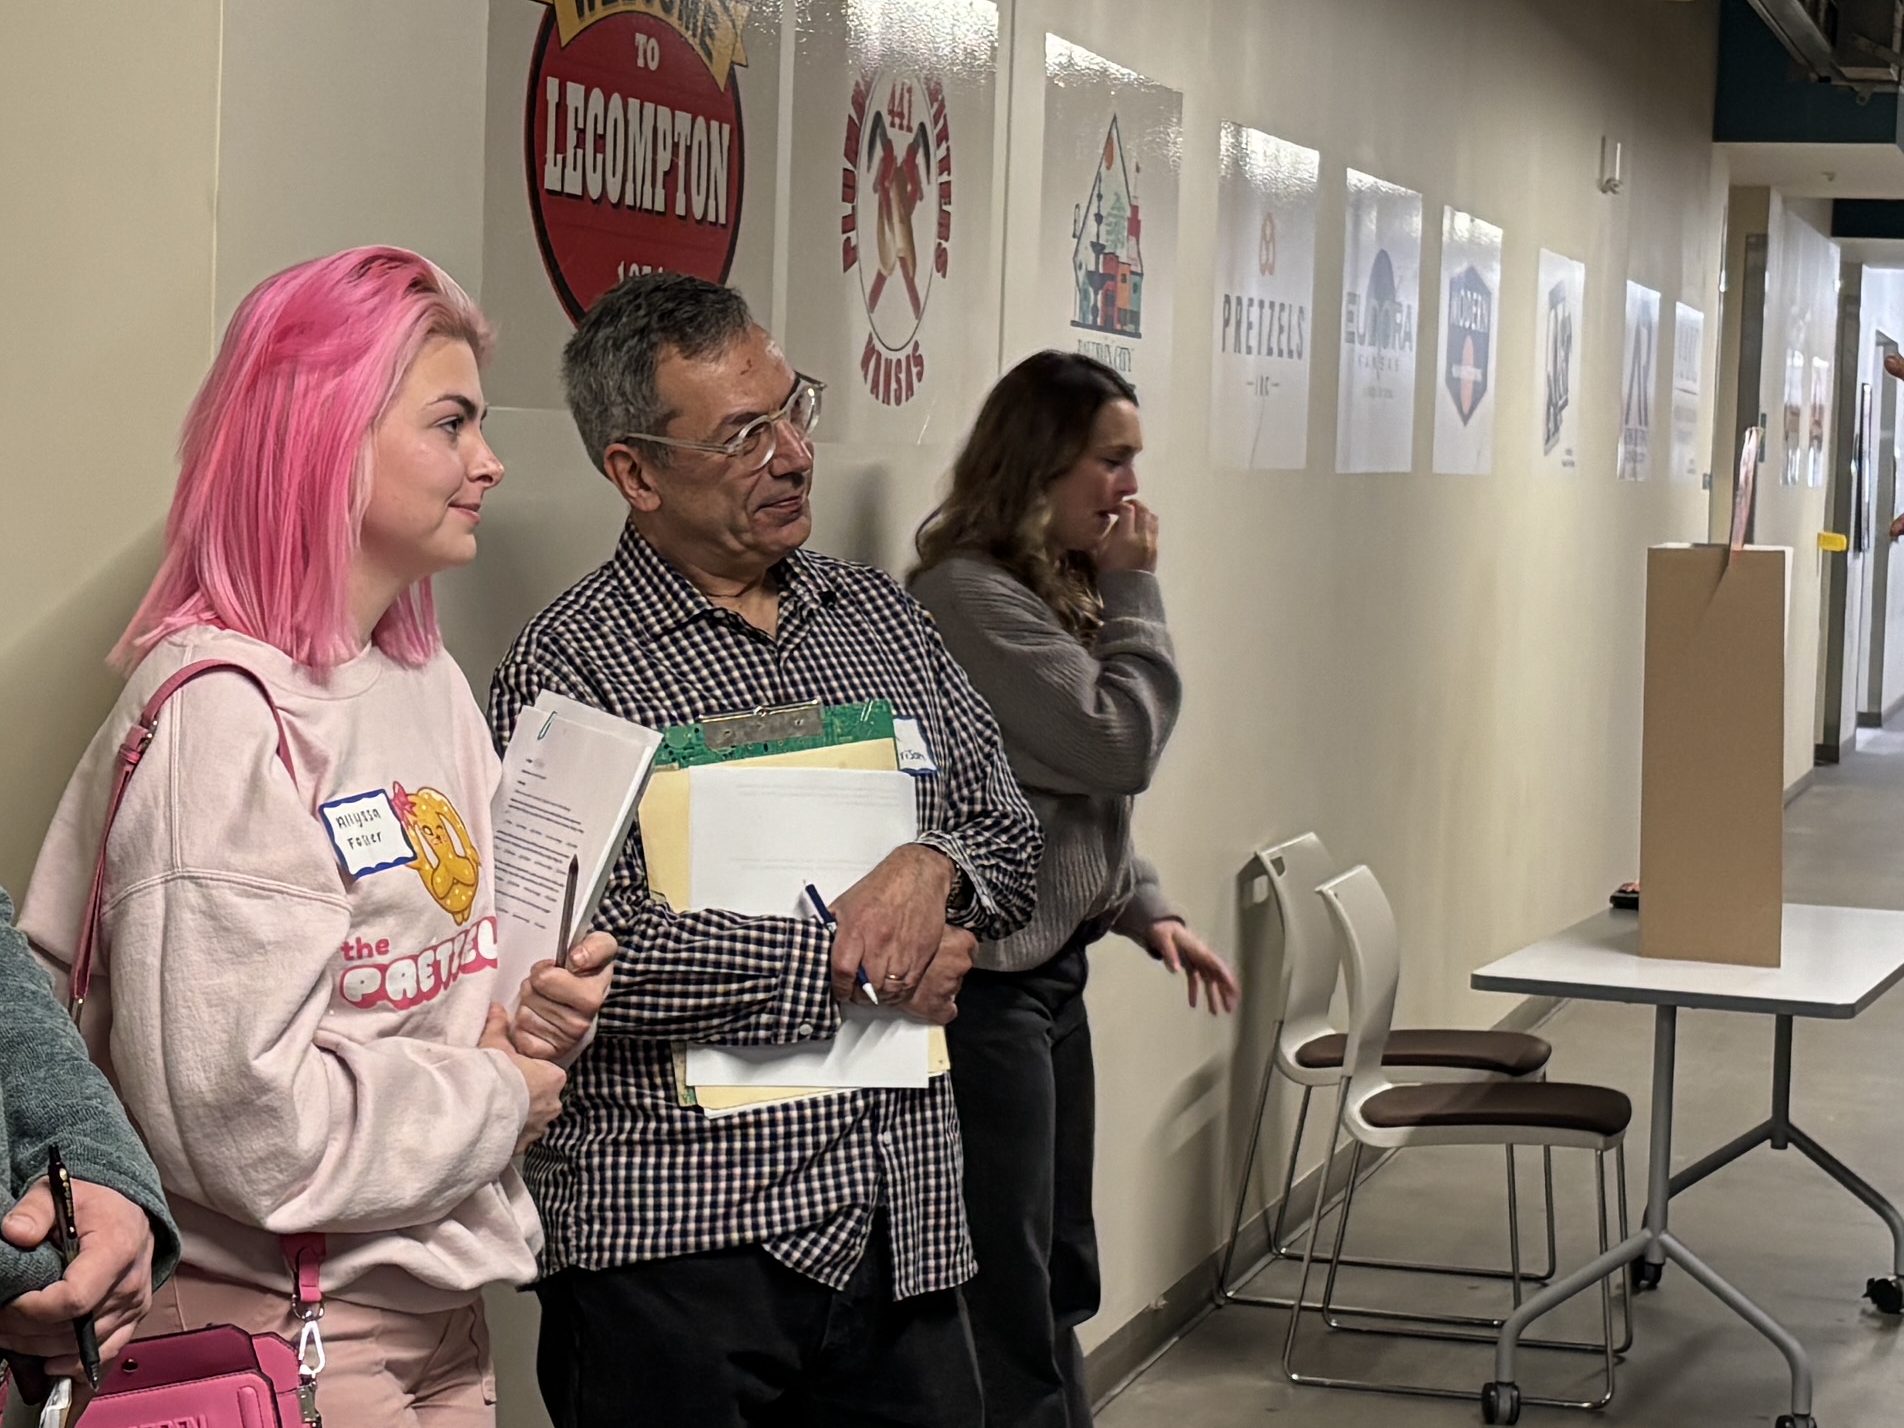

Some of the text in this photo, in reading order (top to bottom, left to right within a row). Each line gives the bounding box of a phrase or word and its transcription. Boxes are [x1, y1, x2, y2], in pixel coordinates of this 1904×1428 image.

[635, 32, 660, 71] TO
[887, 80, 913, 133] 441
[544, 76, 731, 225] LECOMPTON
[1222, 293, 1305, 361] PRETZELS
[1345, 291, 1413, 353] EUDORA
[860, 330, 924, 407] KANSAS
[340, 937, 391, 962] the
